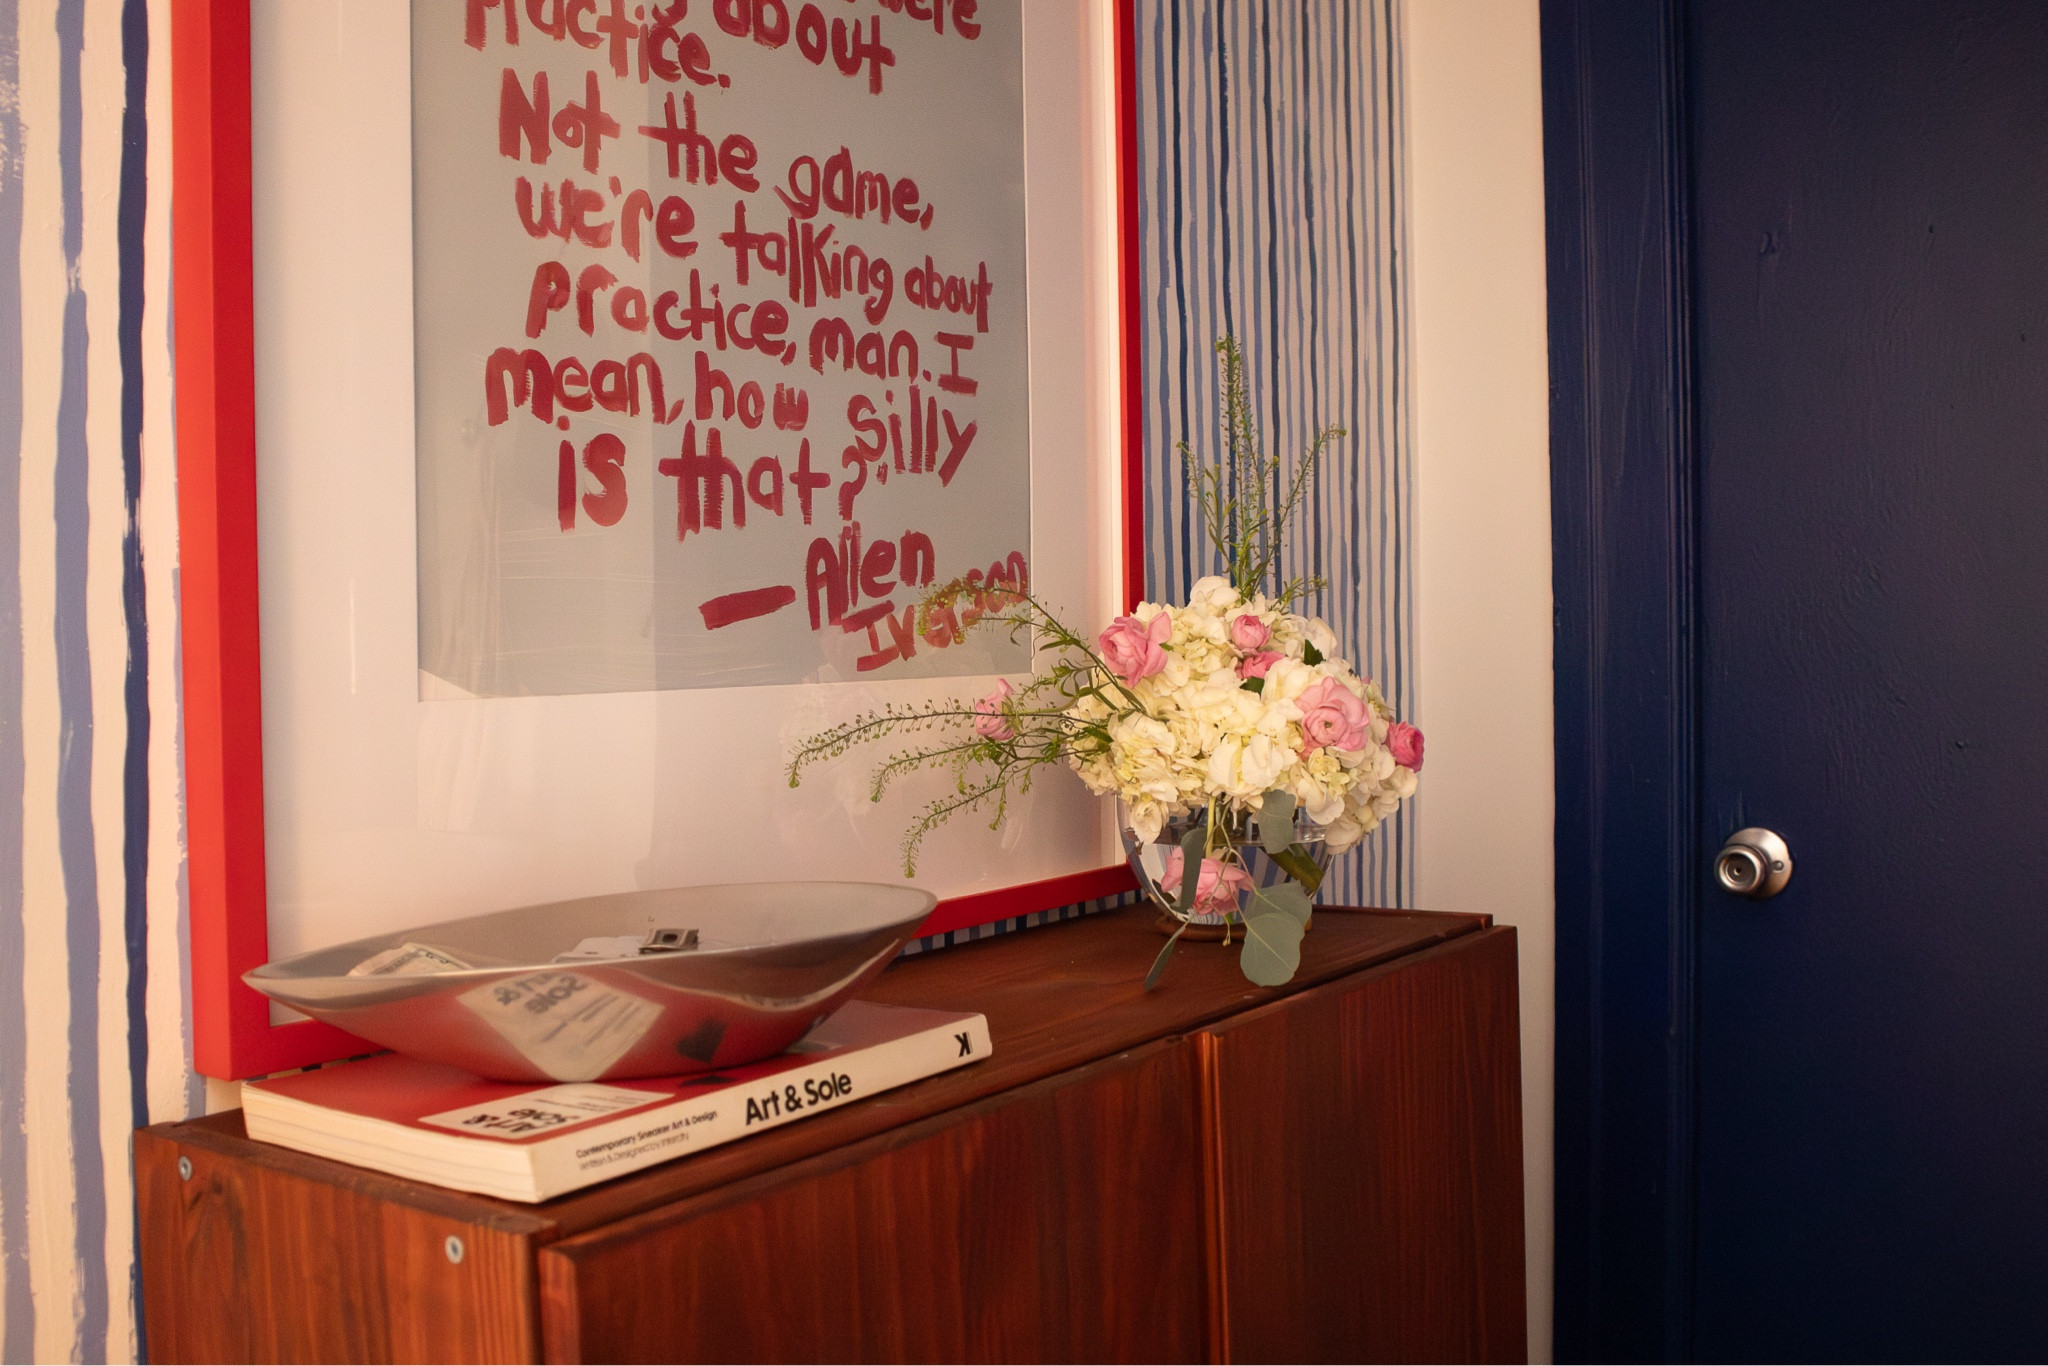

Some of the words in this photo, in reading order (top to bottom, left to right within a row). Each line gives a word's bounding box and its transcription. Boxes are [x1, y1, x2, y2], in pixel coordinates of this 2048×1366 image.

[712, 0, 896, 95] about
[498, 68, 620, 174] Not
[638, 91, 760, 192] the
[773, 146, 933, 230] game,
[515, 176, 698, 261] we're
[719, 200, 893, 324] talking
[904, 255, 992, 332] about
[526, 261, 796, 365] practice,
[808, 317, 931, 384] man.
[936, 331, 978, 396] I
[485, 347, 684, 426] mean,
[695, 351, 809, 431] how
[557, 415, 628, 532] is
[659, 420, 887, 543] that?
[805, 521, 935, 631] Allen
[575, 1134, 636, 1158] Contemporary
[637, 1124, 670, 1141] Sneaker
[671, 1120, 684, 1130] Art
[684, 1117, 691, 1126] &
[691, 1110, 717, 1125] Design
[746, 1090, 780, 1126] Art
[785, 1084, 803, 1112] &
[803, 1073, 852, 1106] Sole
